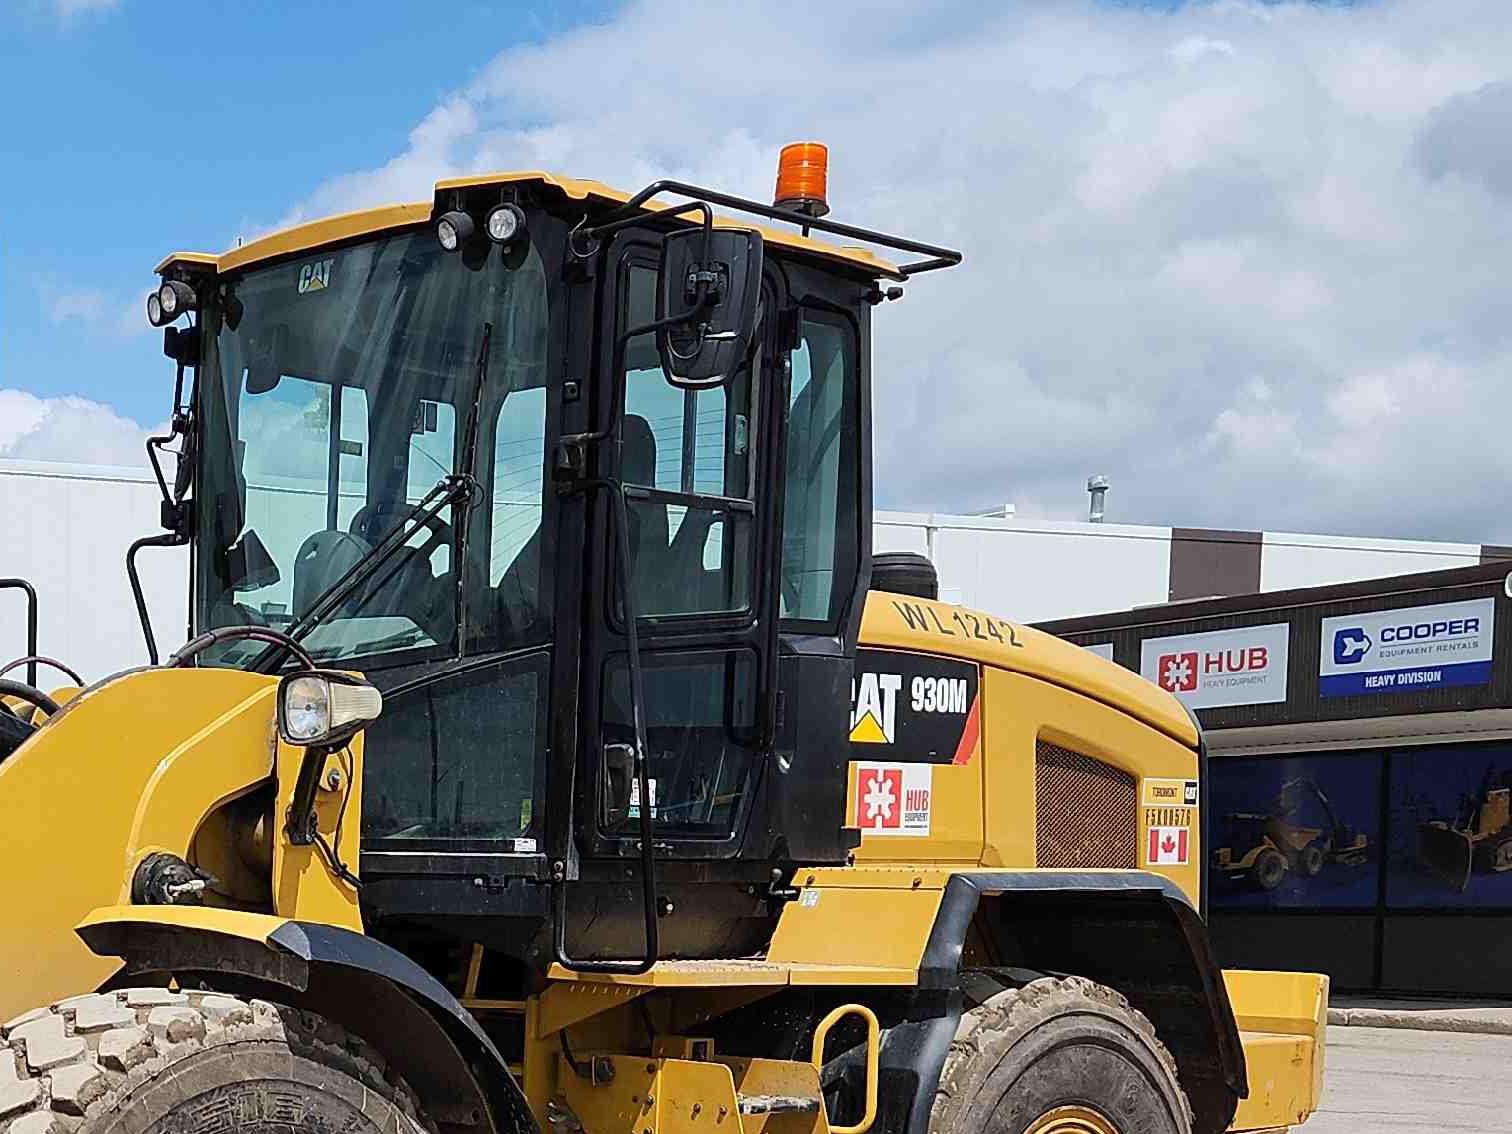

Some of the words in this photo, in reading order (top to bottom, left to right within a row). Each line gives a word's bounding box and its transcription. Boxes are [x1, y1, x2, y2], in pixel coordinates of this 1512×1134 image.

[299, 259, 335, 294] CAT
[1380, 618, 1480, 643] COOPER
[1204, 647, 1268, 673] HUB
[1379, 646, 1433, 658] EQUIPMENT
[1436, 641, 1479, 653] RENTALS
[1365, 674, 1395, 688] HEAVY
[1397, 671, 1442, 686] DIVISION
[849, 672, 902, 744] AT
[911, 676, 967, 713] 930M
[905, 787, 929, 812] HUB
